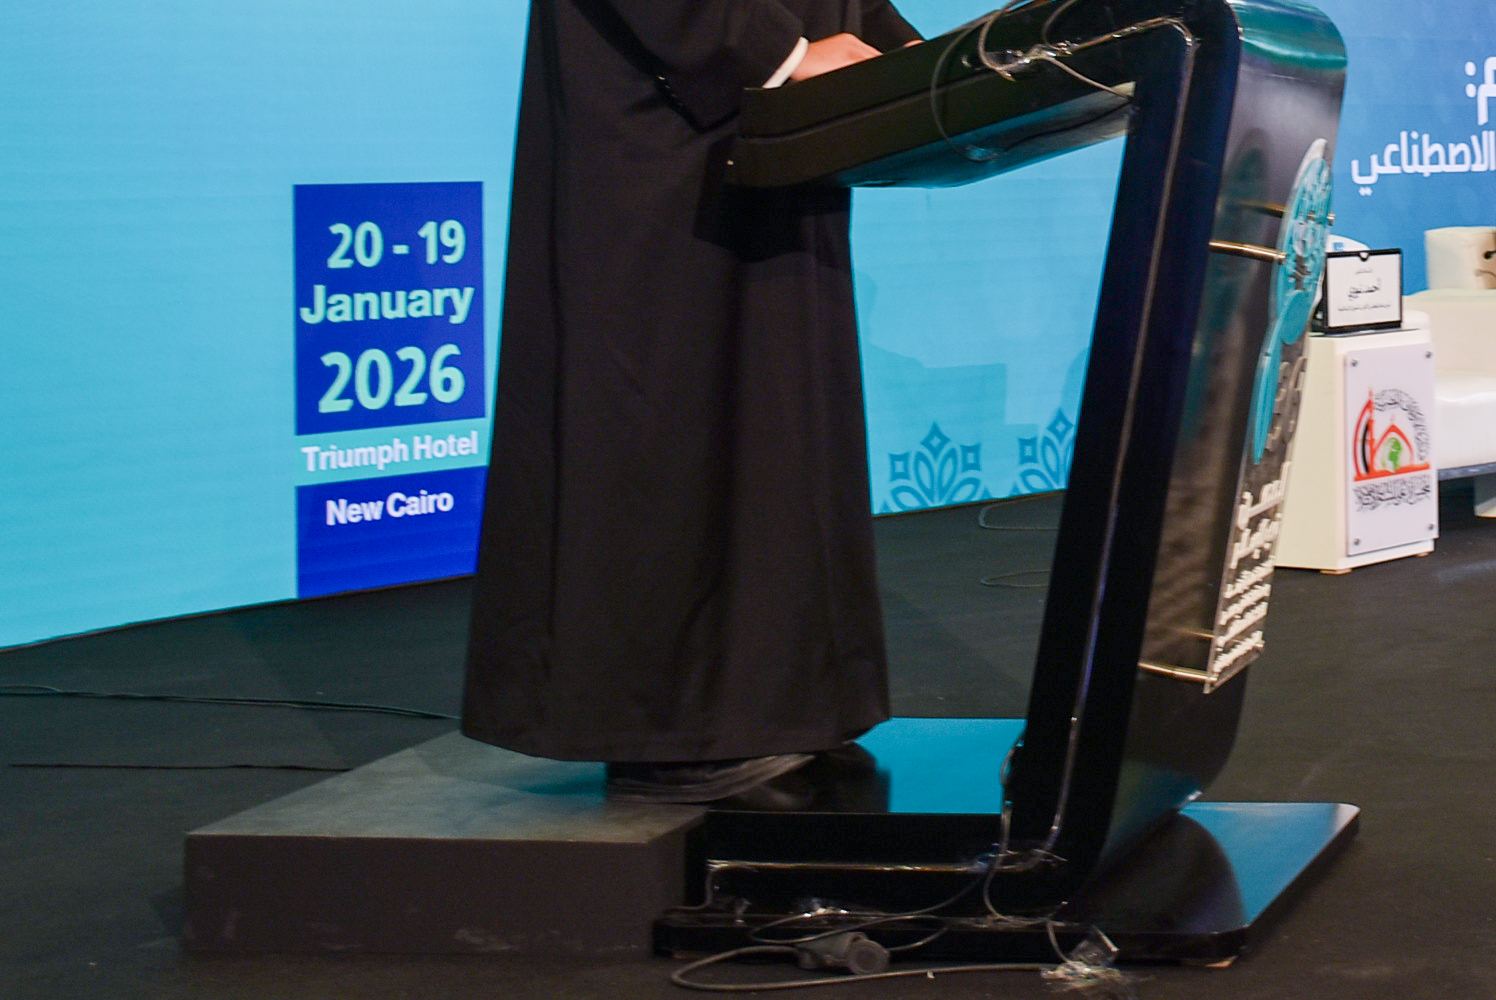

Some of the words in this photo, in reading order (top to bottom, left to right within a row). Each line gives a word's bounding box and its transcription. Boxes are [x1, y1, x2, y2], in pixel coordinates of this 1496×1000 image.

[1351, 130, 1496, 196] الاصطناعي
[327, 221, 384, 268] 20
[417, 219, 466, 265] 19
[300, 284, 475, 325] January
[318, 344, 466, 413] 2026
[301, 437, 409, 473] Triumph
[412, 430, 479, 463] Hotel
[325, 498, 383, 526] New
[386, 490, 455, 520] Cairo
